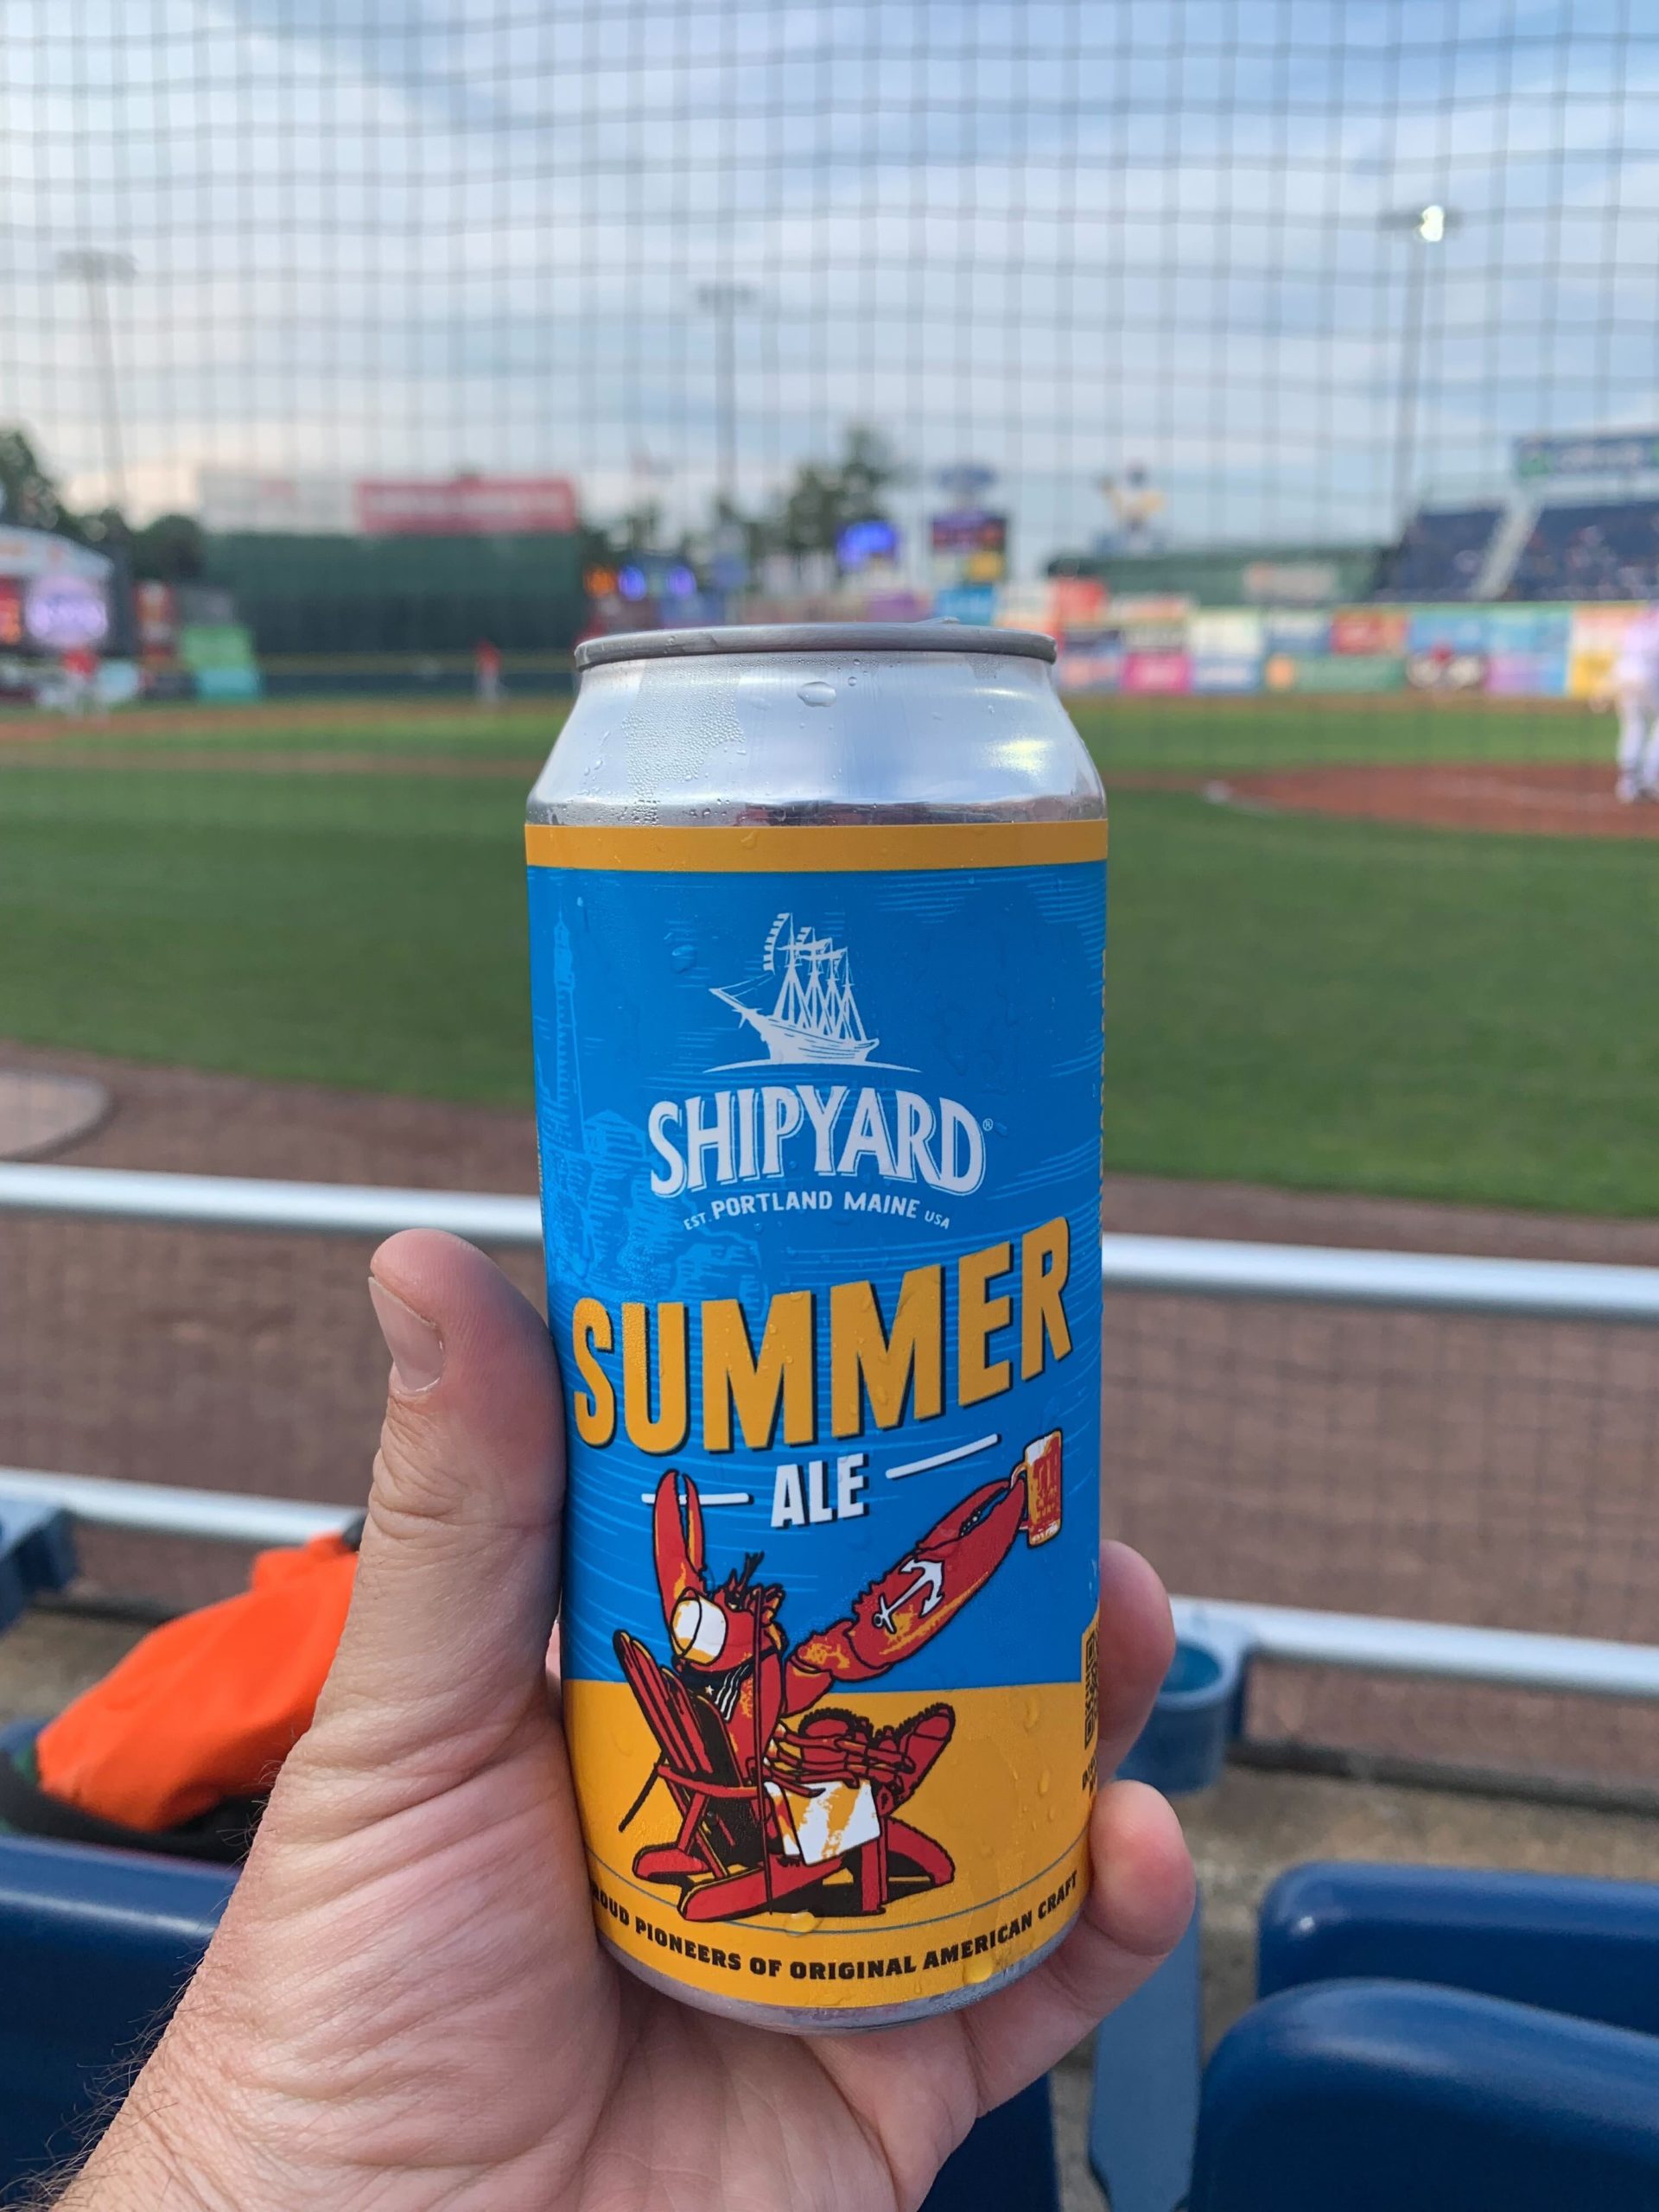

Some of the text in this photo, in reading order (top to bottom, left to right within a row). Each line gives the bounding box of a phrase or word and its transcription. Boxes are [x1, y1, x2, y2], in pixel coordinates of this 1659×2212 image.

[683, 1190, 950, 1231] EST. PORTLAND MAINE USA
[572, 1216, 1072, 1455] SUMMER
[770, 1453, 869, 1529] ALE
[591, 1869, 1077, 1980] ROUD PIONEERS OF ORIGINAL AMERICAN CRAFT
